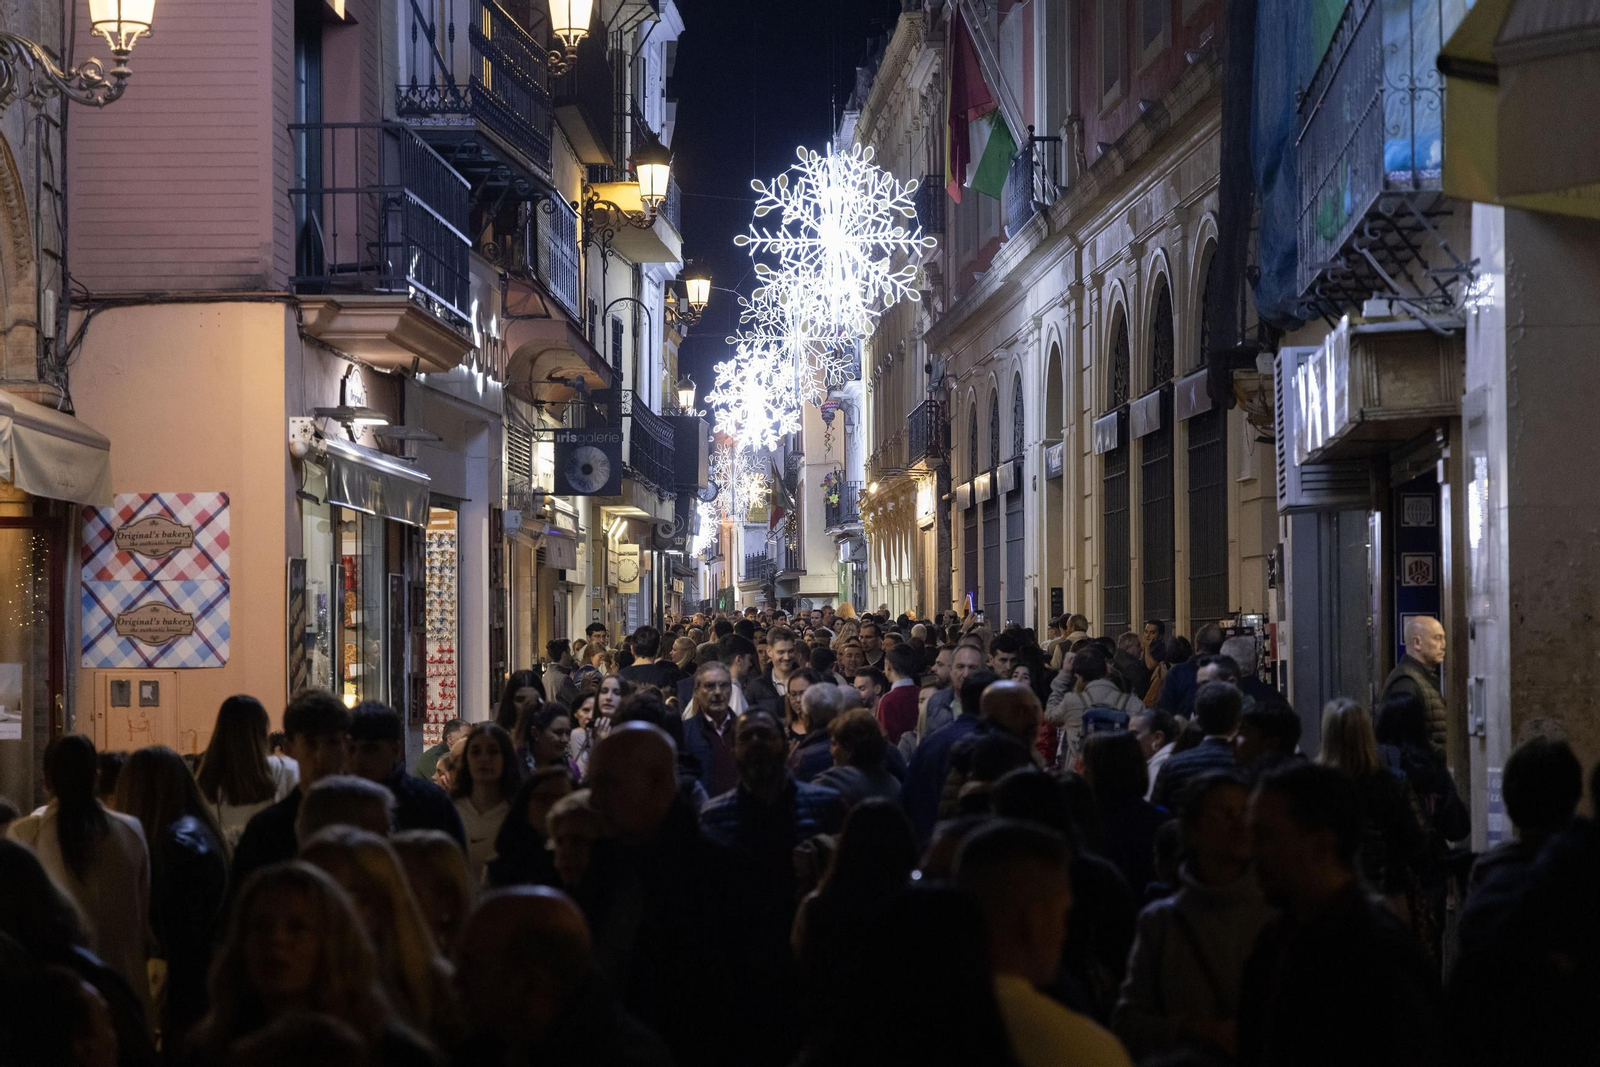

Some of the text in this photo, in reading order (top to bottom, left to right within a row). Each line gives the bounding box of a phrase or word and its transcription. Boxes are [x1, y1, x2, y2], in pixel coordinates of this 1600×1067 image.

[117, 530, 192, 541] Original's bakery
[117, 617, 192, 628] Original's bakery
